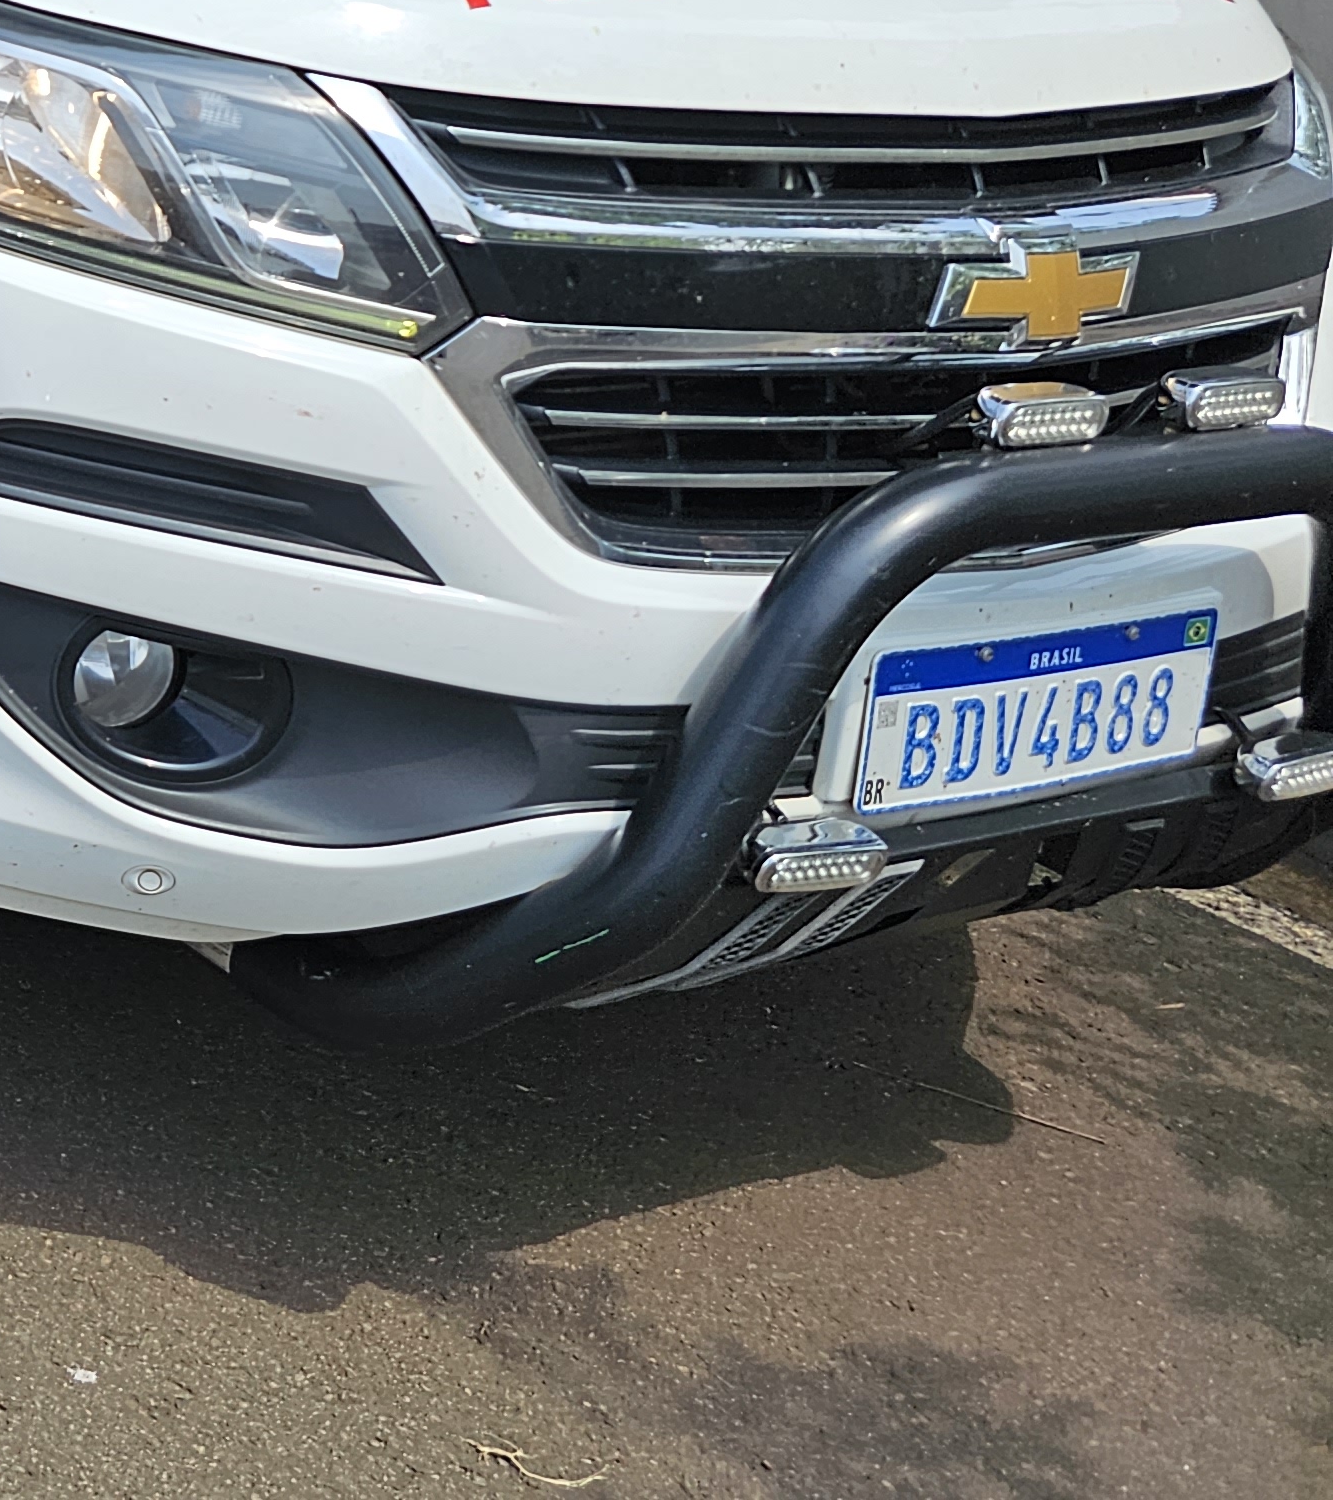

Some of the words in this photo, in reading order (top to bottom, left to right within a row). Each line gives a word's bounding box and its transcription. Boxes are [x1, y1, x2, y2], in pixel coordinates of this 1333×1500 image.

[1029, 646, 1084, 670] BRASIL
[897, 664, 1174, 791] BDV4B88
[862, 779, 884, 806] BR
